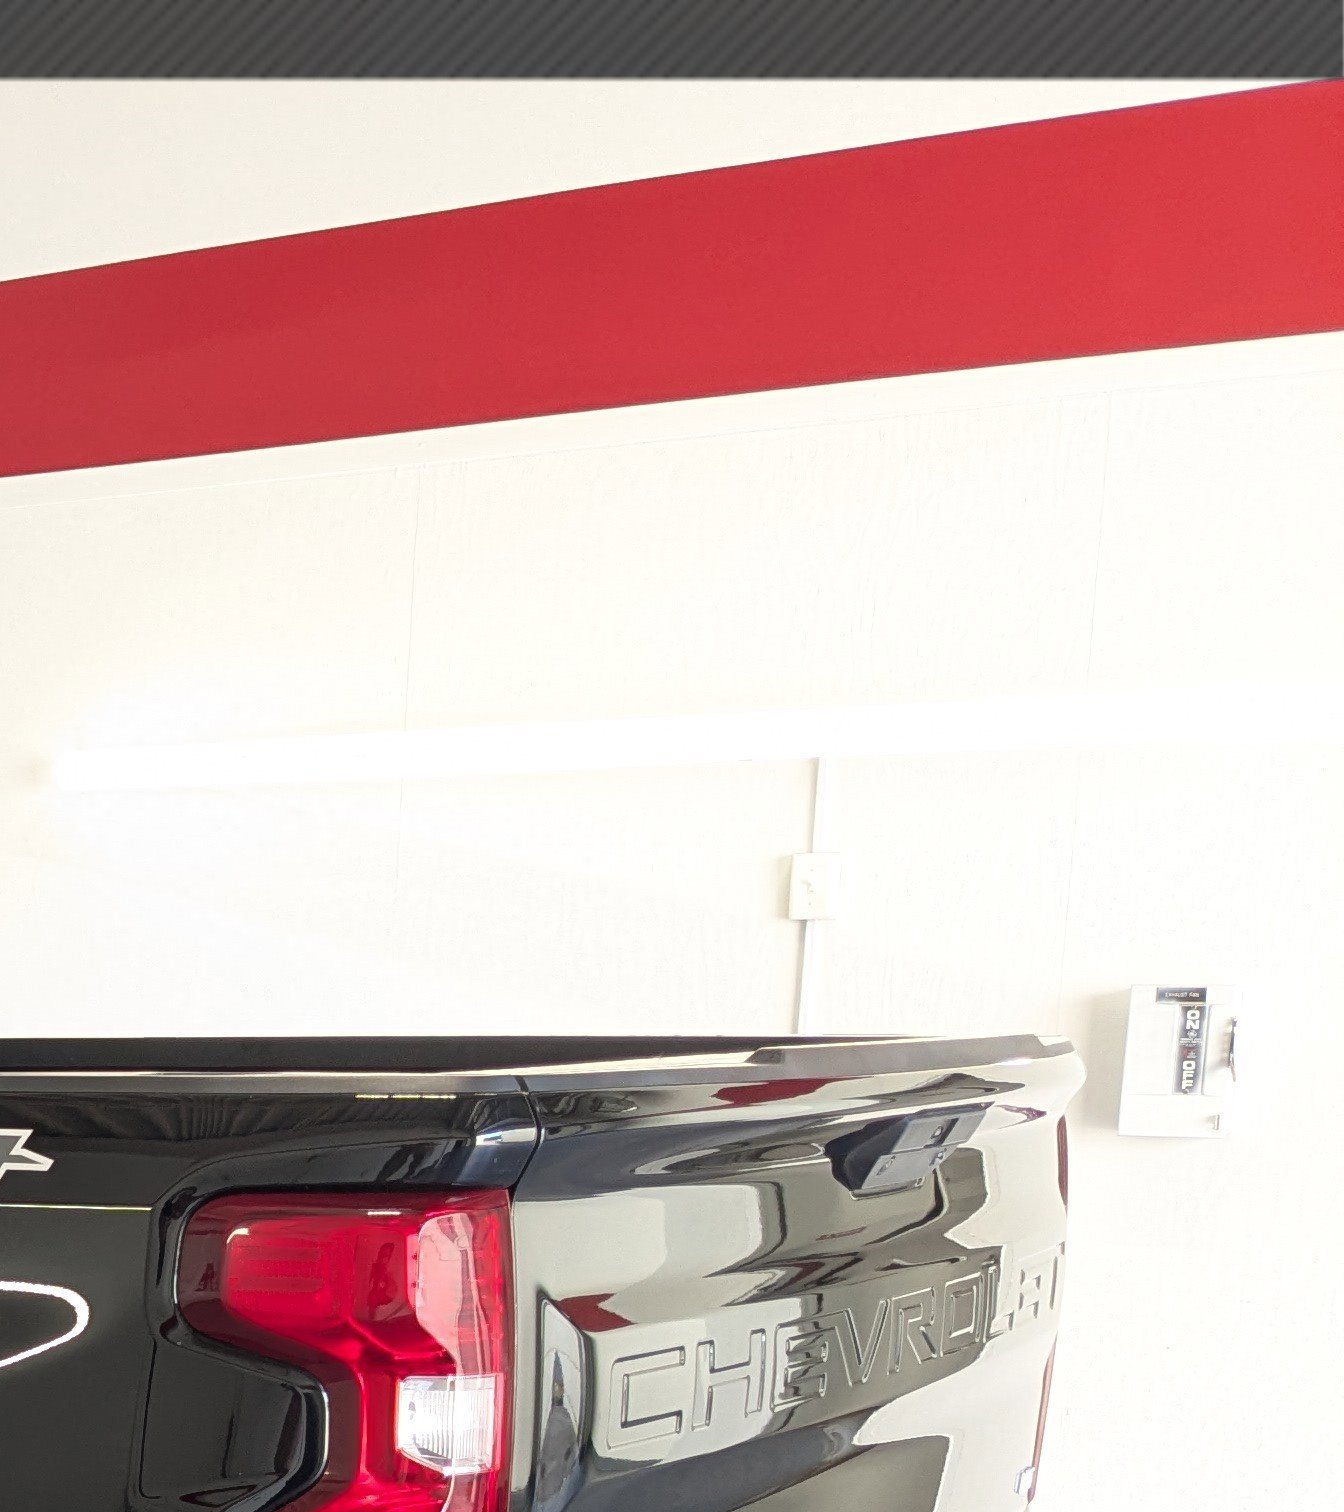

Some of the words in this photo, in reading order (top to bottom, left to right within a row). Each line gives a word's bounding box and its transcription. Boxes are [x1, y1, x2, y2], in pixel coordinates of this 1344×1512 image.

[1185, 1009, 1201, 1030] ON
[1181, 1060, 1197, 1090] OFF
[608, 1242, 1064, 1450] CHEVROLET
